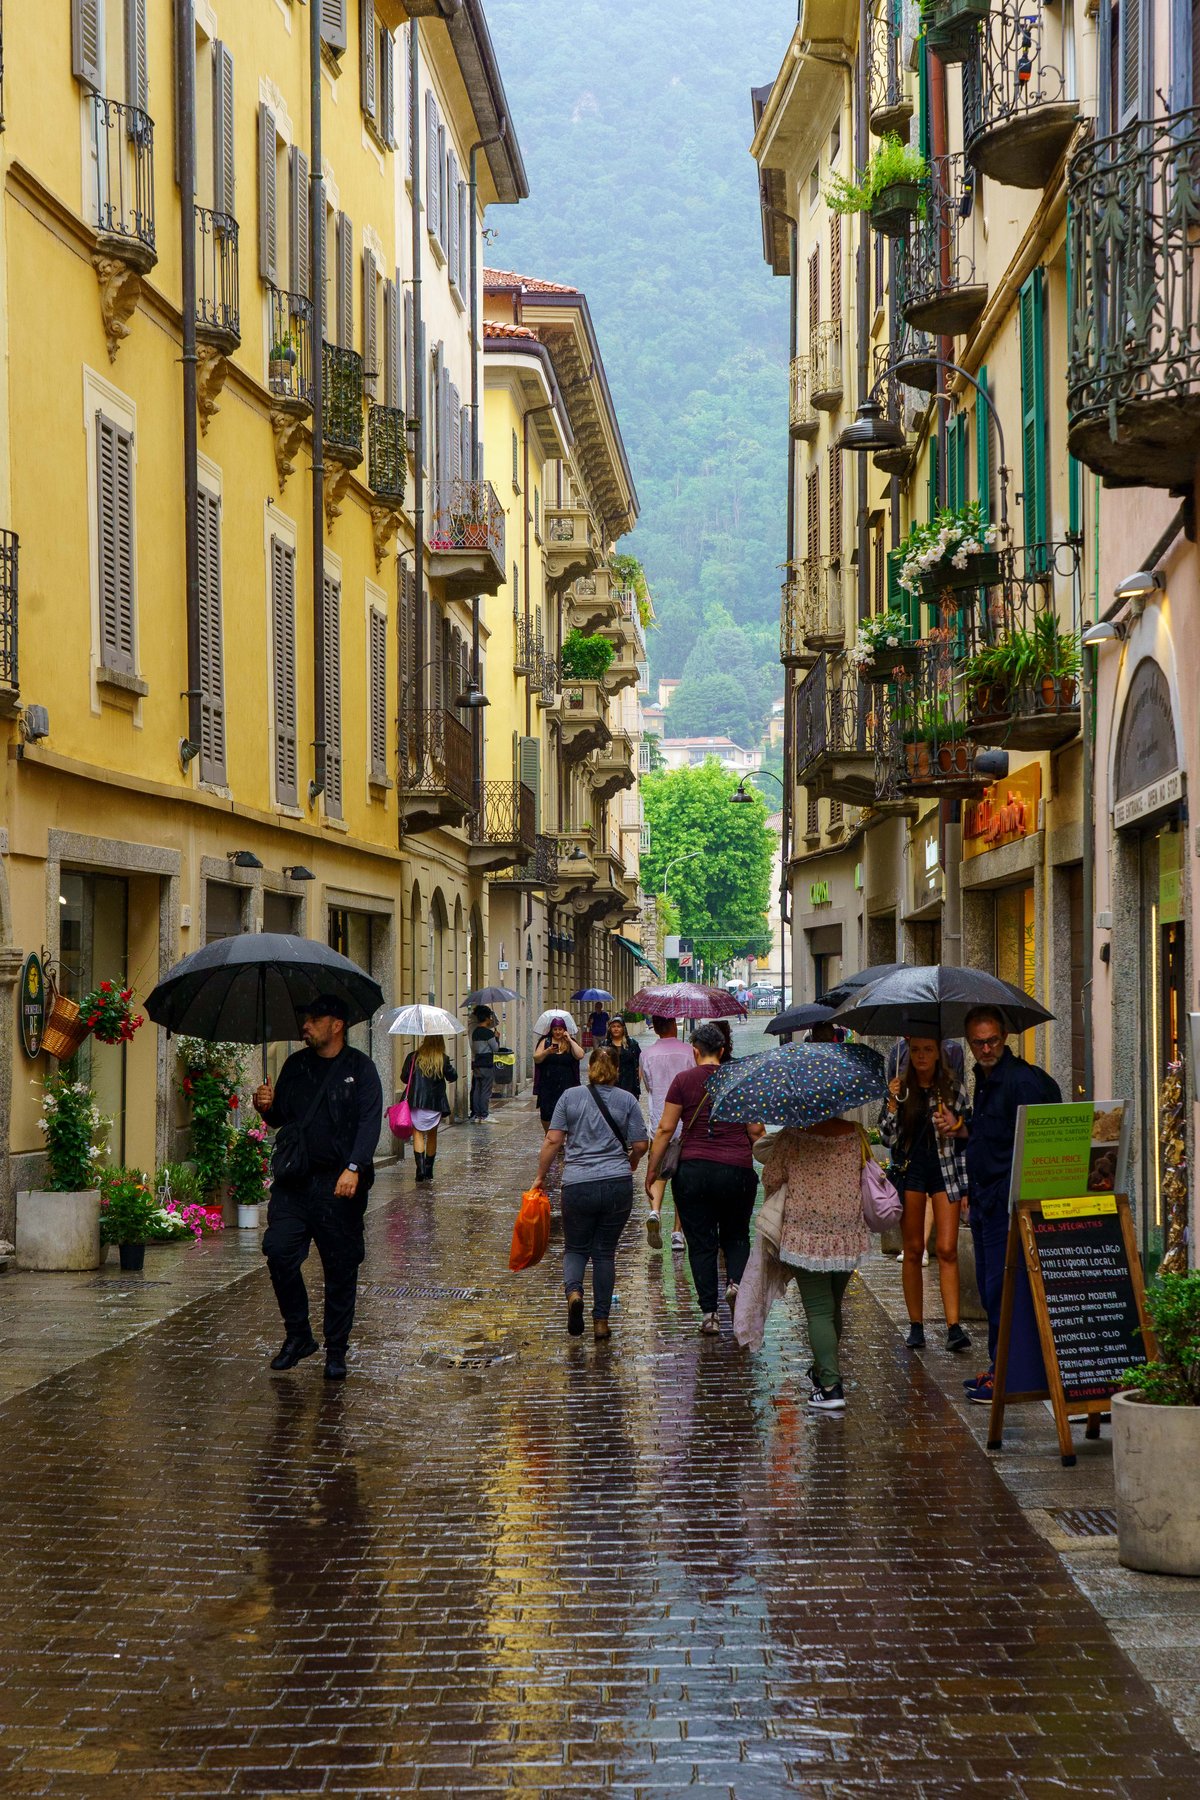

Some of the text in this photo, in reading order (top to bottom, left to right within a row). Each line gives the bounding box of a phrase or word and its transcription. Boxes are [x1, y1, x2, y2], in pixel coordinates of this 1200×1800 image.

[1168, 776, 1178, 798] STOP
[1027, 1115, 1090, 1126] PREZZO SPECIALE
[1032, 1154, 1082, 1166] SPECIAL PRICE
[1034, 1224, 1056, 1232] LOCAL
[1102, 1245, 1120, 1254] LAGO
[1062, 1258, 1088, 1269] LIQUORI
[1090, 1258, 1116, 1266] LOCALI
[1046, 1292, 1117, 1302] BALSAMICO MODENA
[1048, 1306, 1080, 1314] BALSAMICO
[1054, 1332, 1096, 1342] LIMONCELLO
